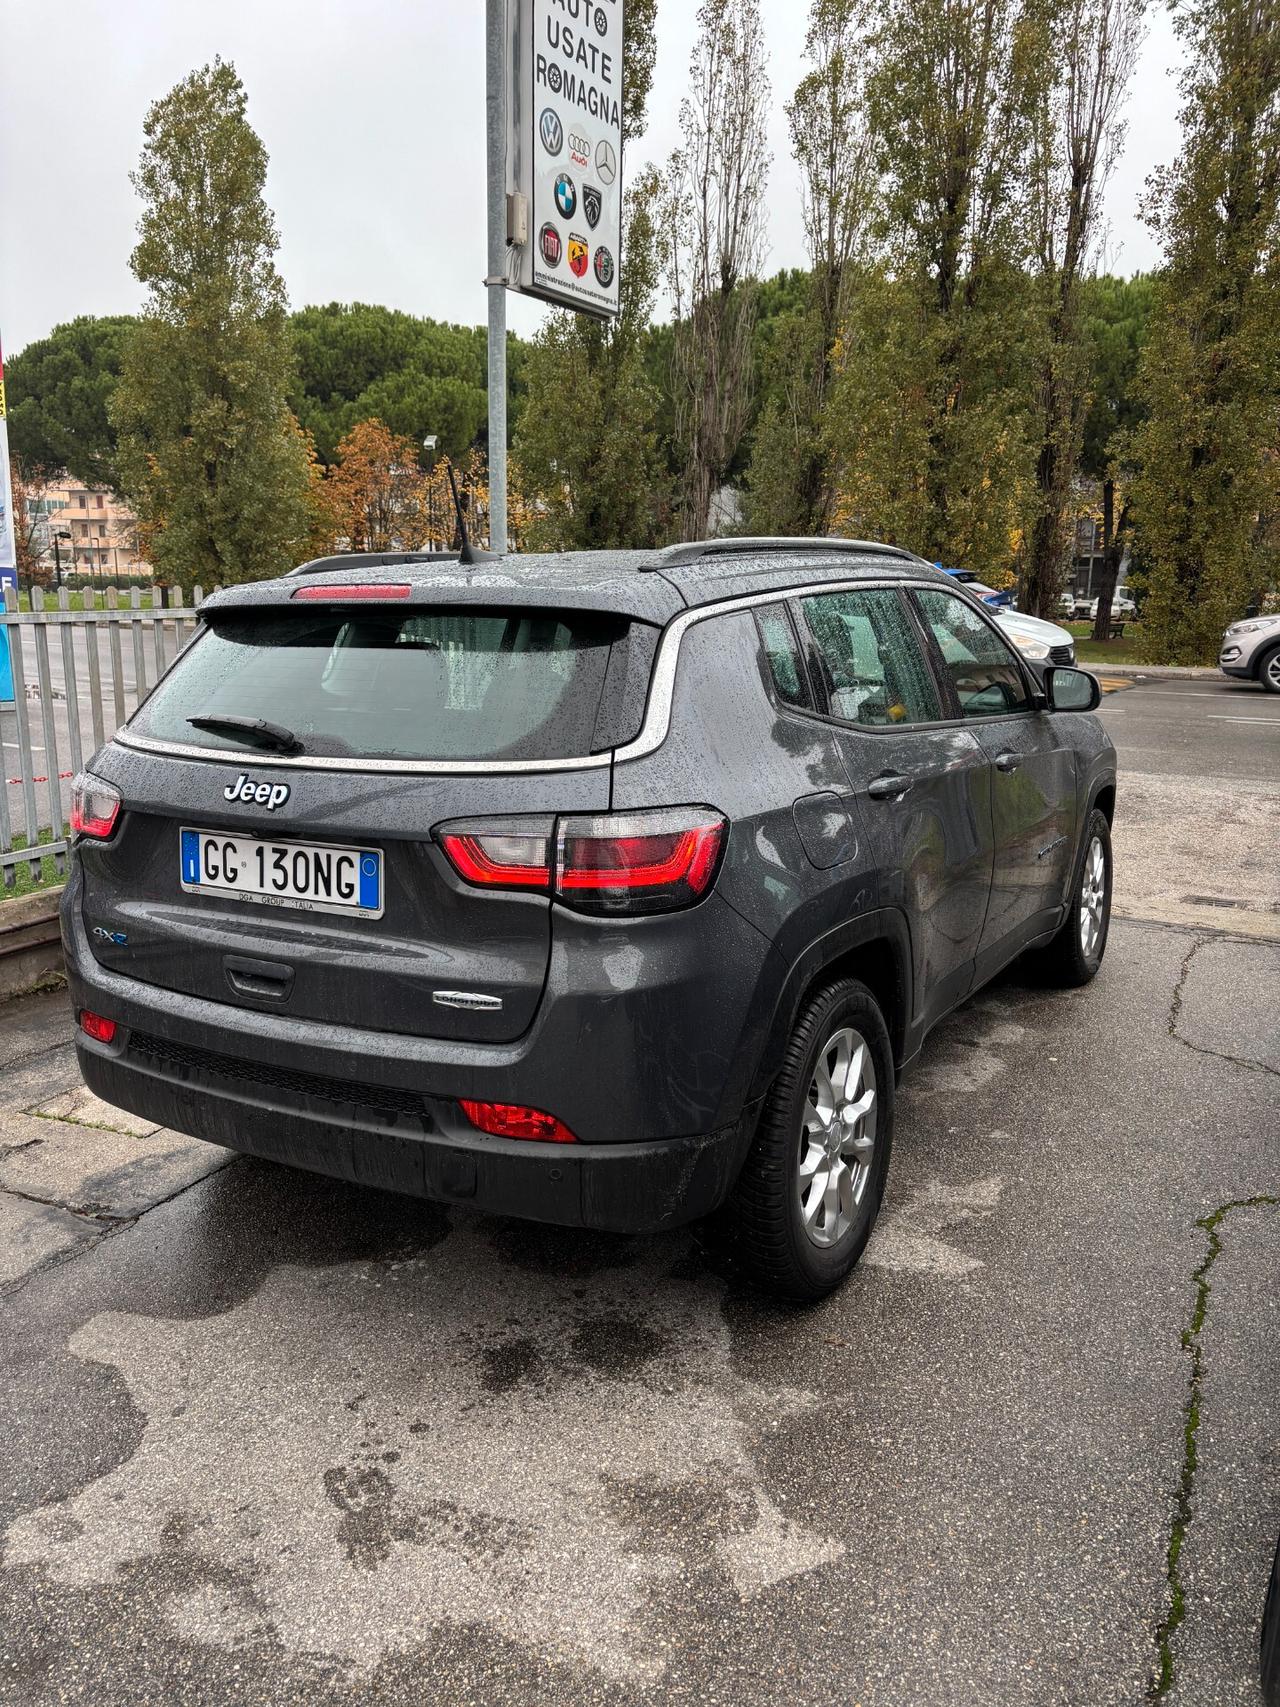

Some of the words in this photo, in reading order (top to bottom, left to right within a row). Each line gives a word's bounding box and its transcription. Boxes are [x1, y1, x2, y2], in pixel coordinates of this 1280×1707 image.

[547, 15, 612, 84] USATE
[536, 53, 620, 130] ROMAGNA
[571, 151, 588, 168] Audi
[224, 774, 290, 811] Jeep
[204, 839, 238, 884] GG
[255, 845, 355, 900] 130NG
[261, 896, 285, 906] GROUP
